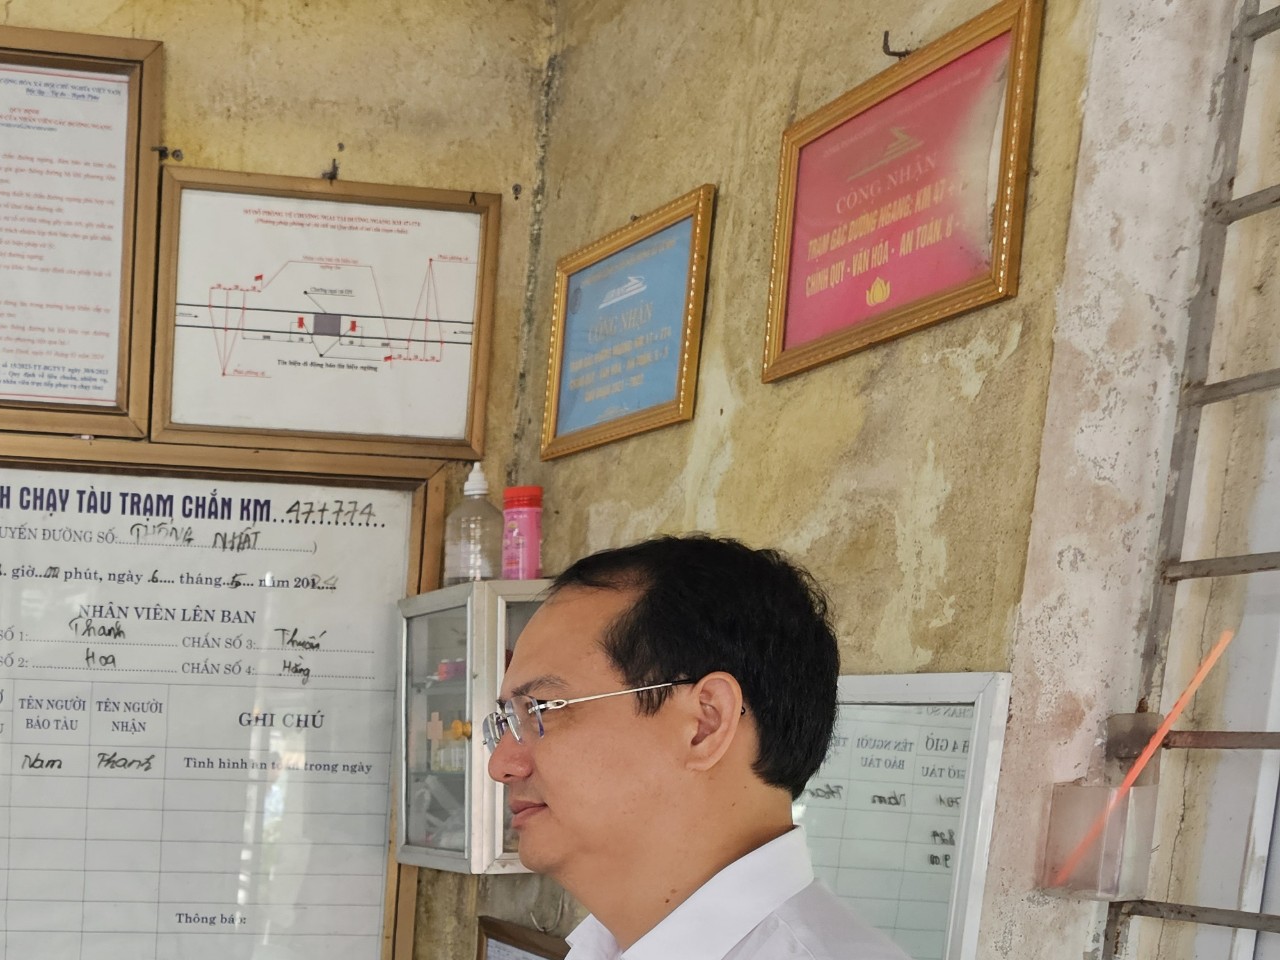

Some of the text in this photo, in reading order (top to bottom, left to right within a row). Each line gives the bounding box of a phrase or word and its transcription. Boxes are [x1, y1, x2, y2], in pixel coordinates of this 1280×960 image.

[19, 486, 70, 517] CHẠY
[76, 486, 112, 514] TÀU
[120, 493, 174, 521] TRẠM
[182, 489, 232, 520] CHẮN
[42, 524, 93, 543] ĐƯỜNG
[108, 570, 143, 585] ngày
[78, 602, 256, 624] NHÂN VIÊN LÊN BAN
[224, 633, 243, 649] SỐ
[223, 660, 242, 675] SỐ
[19, 695, 86, 712] TÊN NGƯỜI
[96, 698, 163, 714] TÊN NGƯỜI
[25, 717, 78, 731] BÁO TÀU
[111, 720, 146, 735] NHẬN
[239, 710, 325, 729] GHI CHÚ
[184, 757, 216, 770] Tình
[342, 762, 373, 775] ngày
[176, 913, 217, 926] Thông
